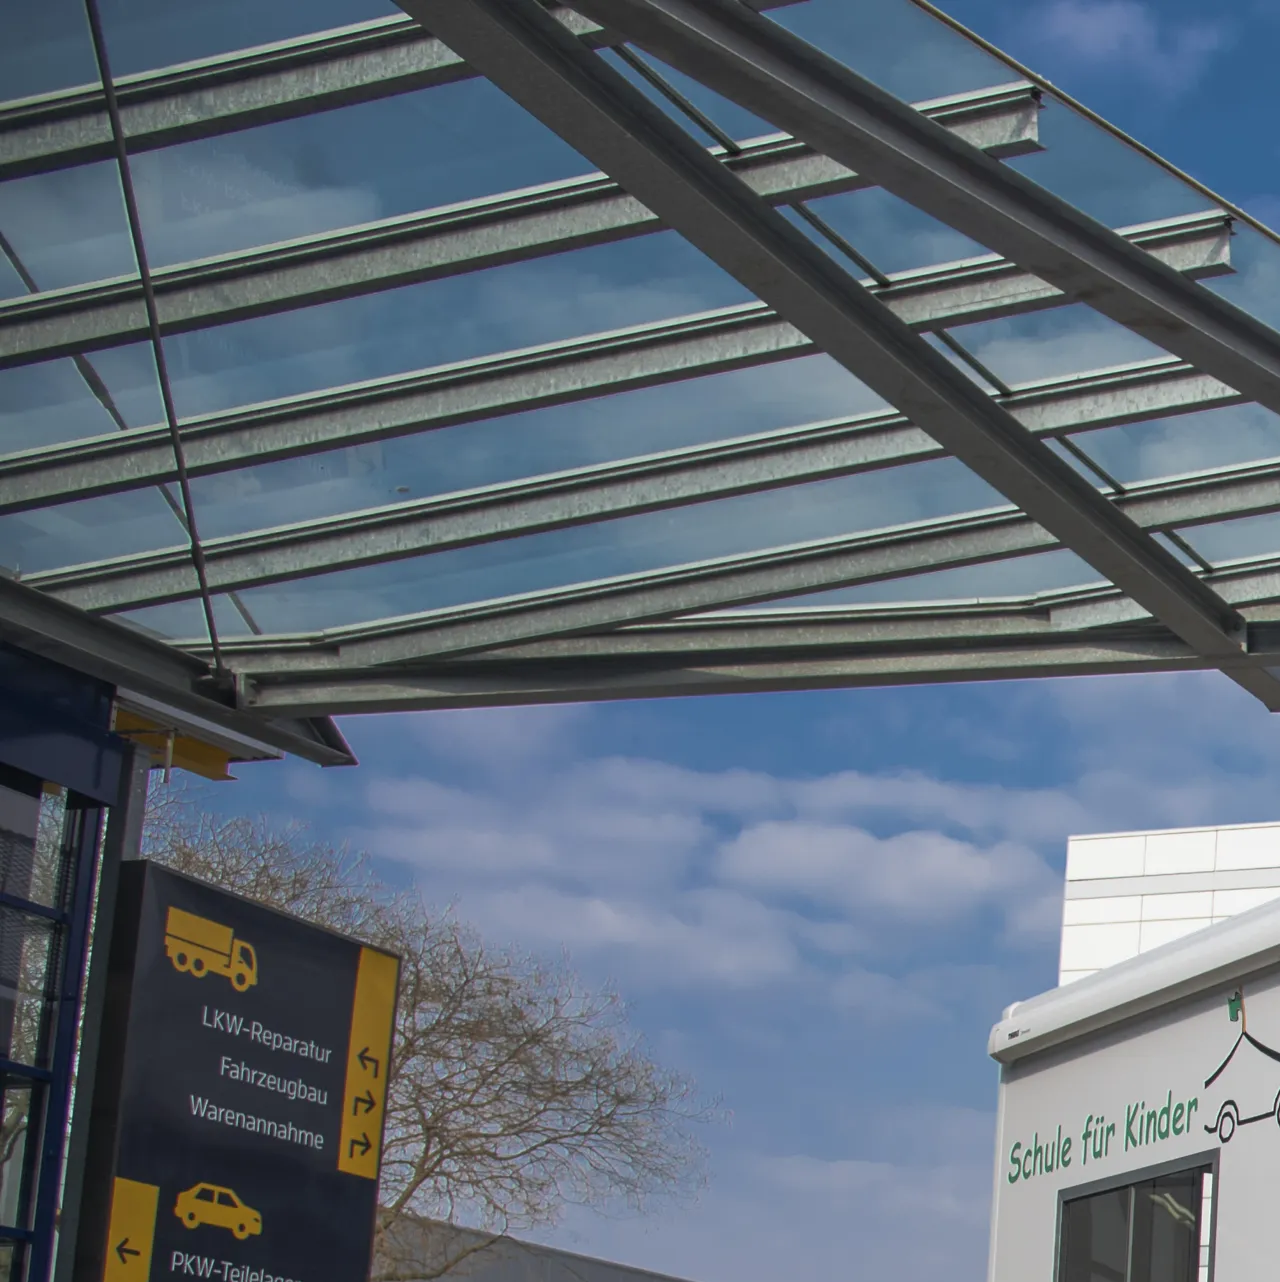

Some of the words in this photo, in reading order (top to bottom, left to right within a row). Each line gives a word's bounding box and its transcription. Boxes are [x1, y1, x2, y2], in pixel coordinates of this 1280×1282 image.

[202, 1006, 332, 1064] LKW-Reparatur
[220, 1057, 328, 1106] Fahrzeugbau
[189, 1096, 325, 1150] Warenannahme
[1007, 1125, 1073, 1183] Schule
[1081, 1115, 1116, 1165] für
[1124, 1090, 1199, 1151] Kinder
